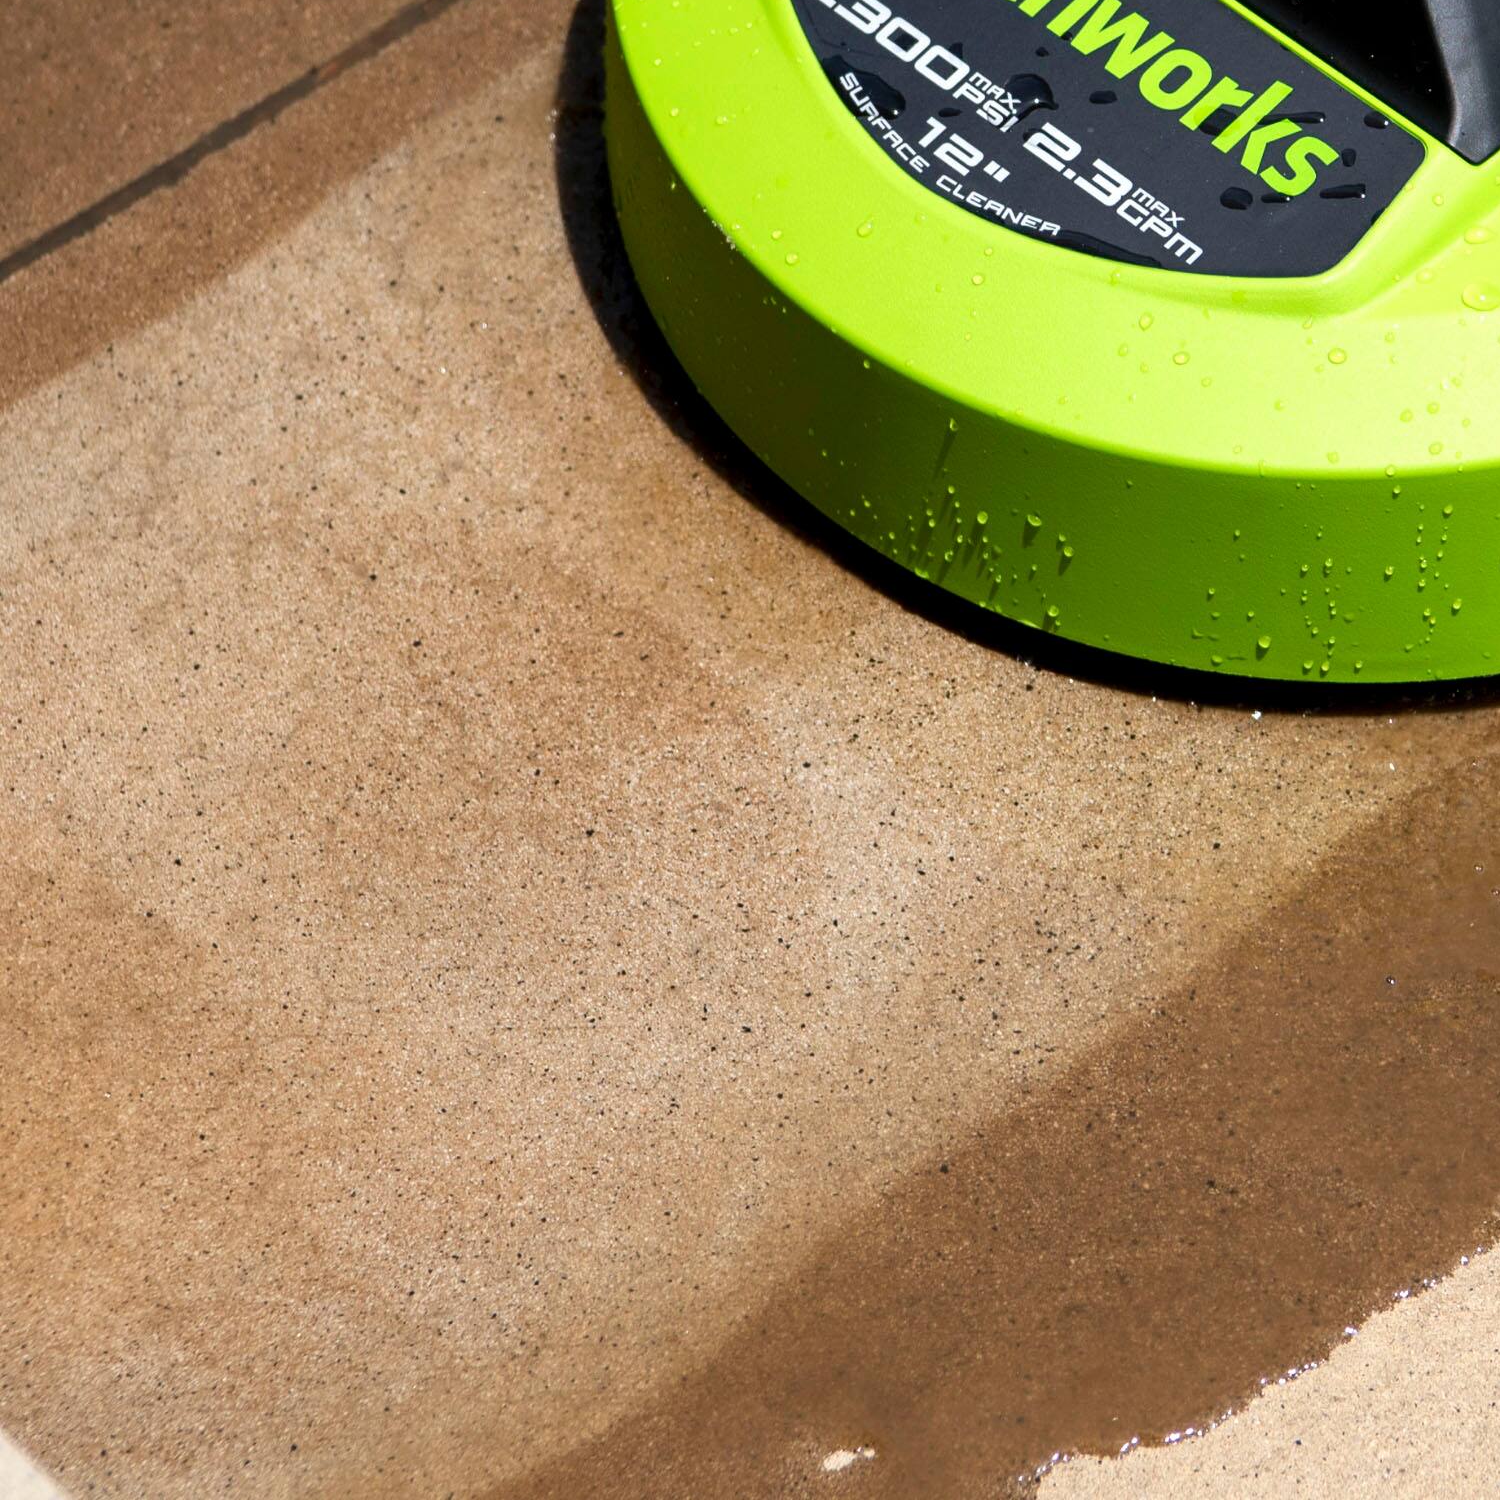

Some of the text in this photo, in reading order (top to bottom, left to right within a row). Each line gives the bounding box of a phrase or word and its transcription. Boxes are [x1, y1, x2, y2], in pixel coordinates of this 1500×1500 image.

[952, 82, 1019, 133] PSI
[839, 72, 1062, 236] SURFACE CLEANER
[918, 116, 1011, 183] 12"
[1022, 121, 1134, 207] 2.3
[1116, 198, 1204, 265] GPM
[1131, 187, 1186, 229] MAX
